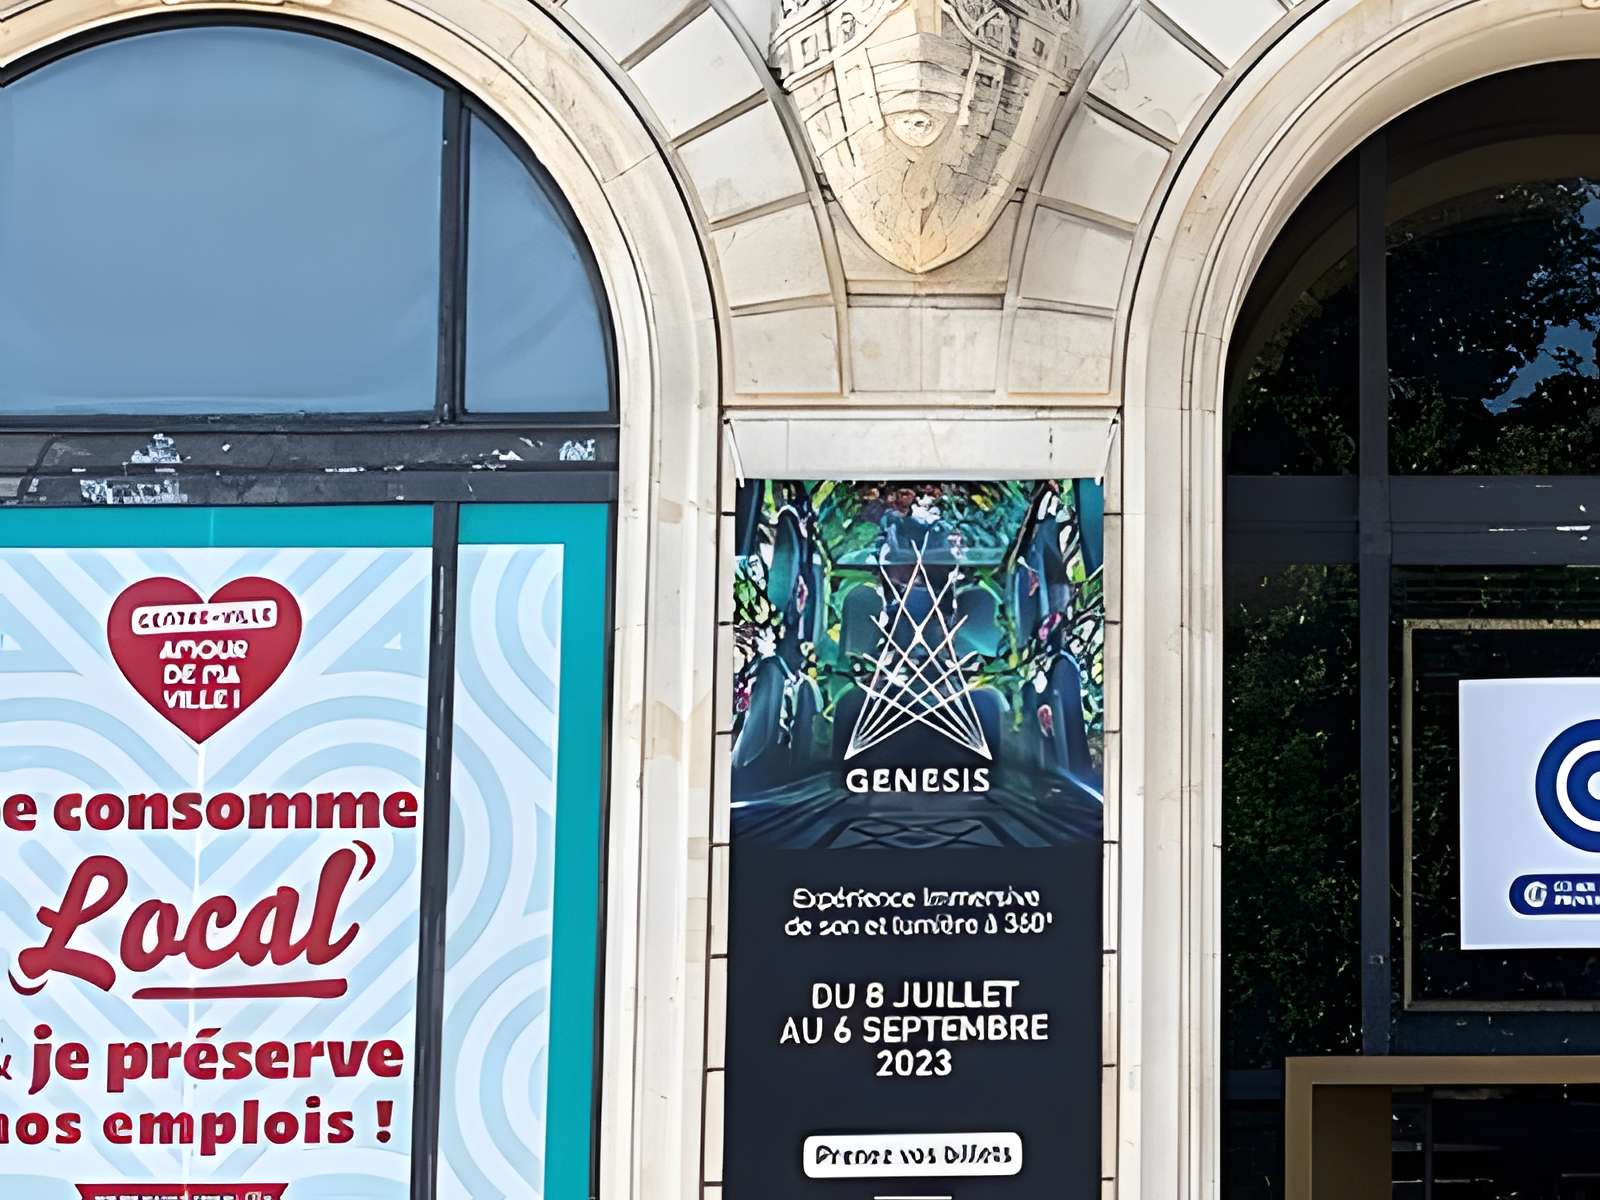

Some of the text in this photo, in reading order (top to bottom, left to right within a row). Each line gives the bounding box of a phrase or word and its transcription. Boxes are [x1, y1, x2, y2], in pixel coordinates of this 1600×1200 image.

[164, 664, 196, 685] DE
[846, 767, 990, 793] GENESIS
[0, 791, 418, 831] e consomme
[16, 846, 362, 993] Local
[812, 980, 1020, 1009] DU 8 JUILLET
[779, 1013, 1049, 1044] AU 6 SEPTEMBRE
[28, 1023, 89, 1095] je
[107, 1027, 404, 1093] préserve
[875, 1048, 952, 1076] 2023
[103, 1096, 354, 1157] emplois
[376, 1100, 393, 1143] !
